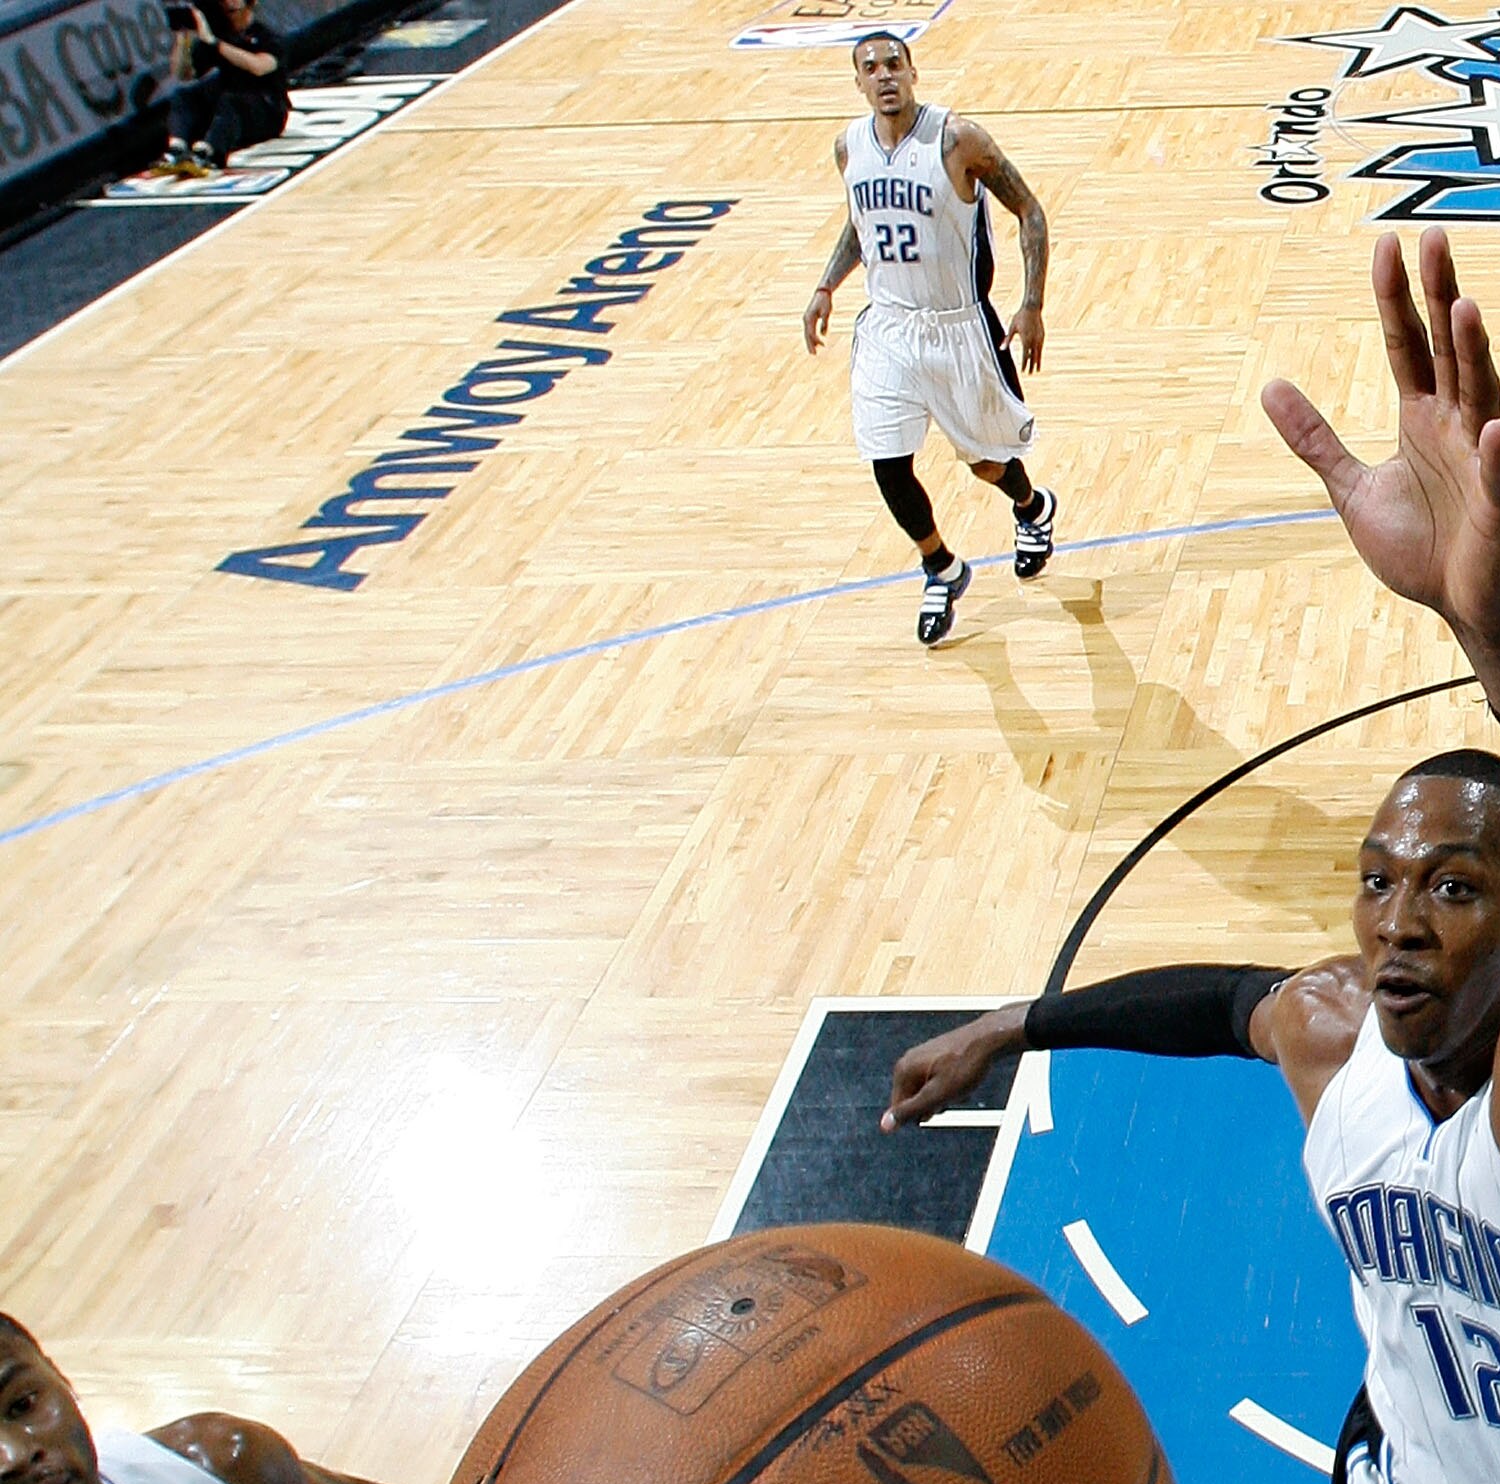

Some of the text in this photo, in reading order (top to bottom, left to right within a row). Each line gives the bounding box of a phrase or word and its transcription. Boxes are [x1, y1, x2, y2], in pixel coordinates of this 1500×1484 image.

[0, 40, 79, 168] BA
[852, 178, 934, 218] MAGIC
[875, 223, 921, 264] 22
[214, 198, 742, 591] Amway Arena
